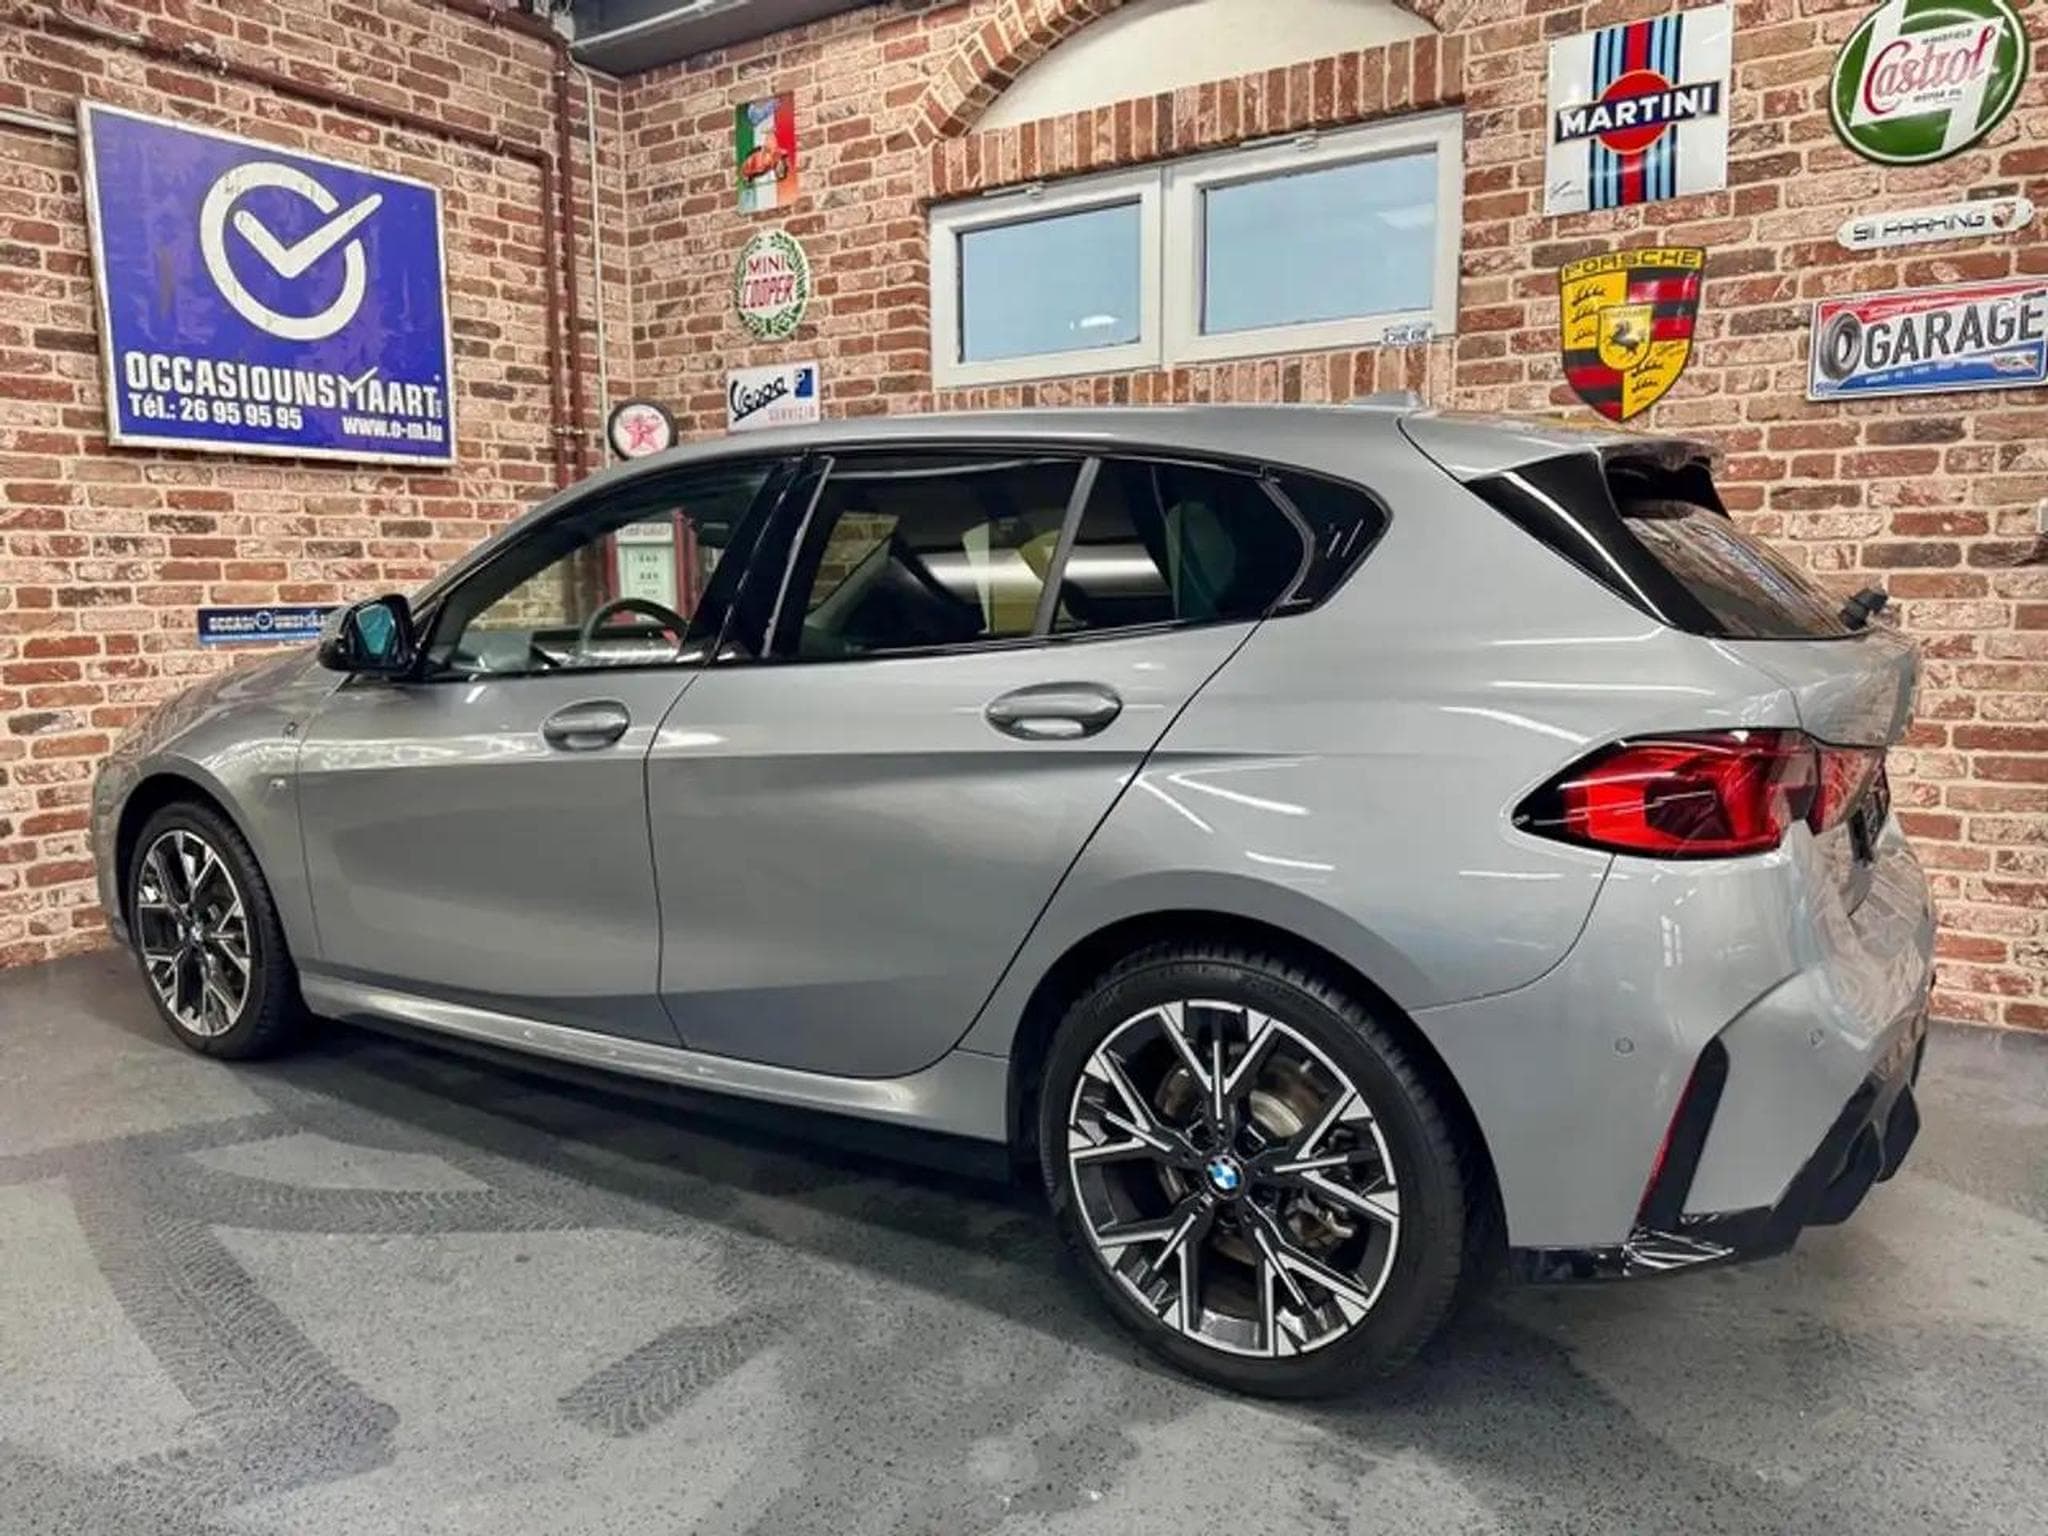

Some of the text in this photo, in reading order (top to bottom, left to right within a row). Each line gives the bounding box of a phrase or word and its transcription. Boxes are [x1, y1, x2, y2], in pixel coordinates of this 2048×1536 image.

[1864, 24, 1996, 115] Castrol
[1560, 86, 1713, 138] MARTINI
[749, 255, 786, 274] MINI
[1564, 251, 1698, 279] PORSCHE
[743, 274, 795, 309] COOPER
[125, 351, 438, 418] OCCASIOUNSMAART
[730, 376, 790, 422] Vespa
[179, 398, 208, 421] 26
[212, 400, 241, 425] 95
[245, 403, 273, 428] 95
[276, 406, 303, 431] 95
[341, 415, 443, 442] www.o-m.lu
